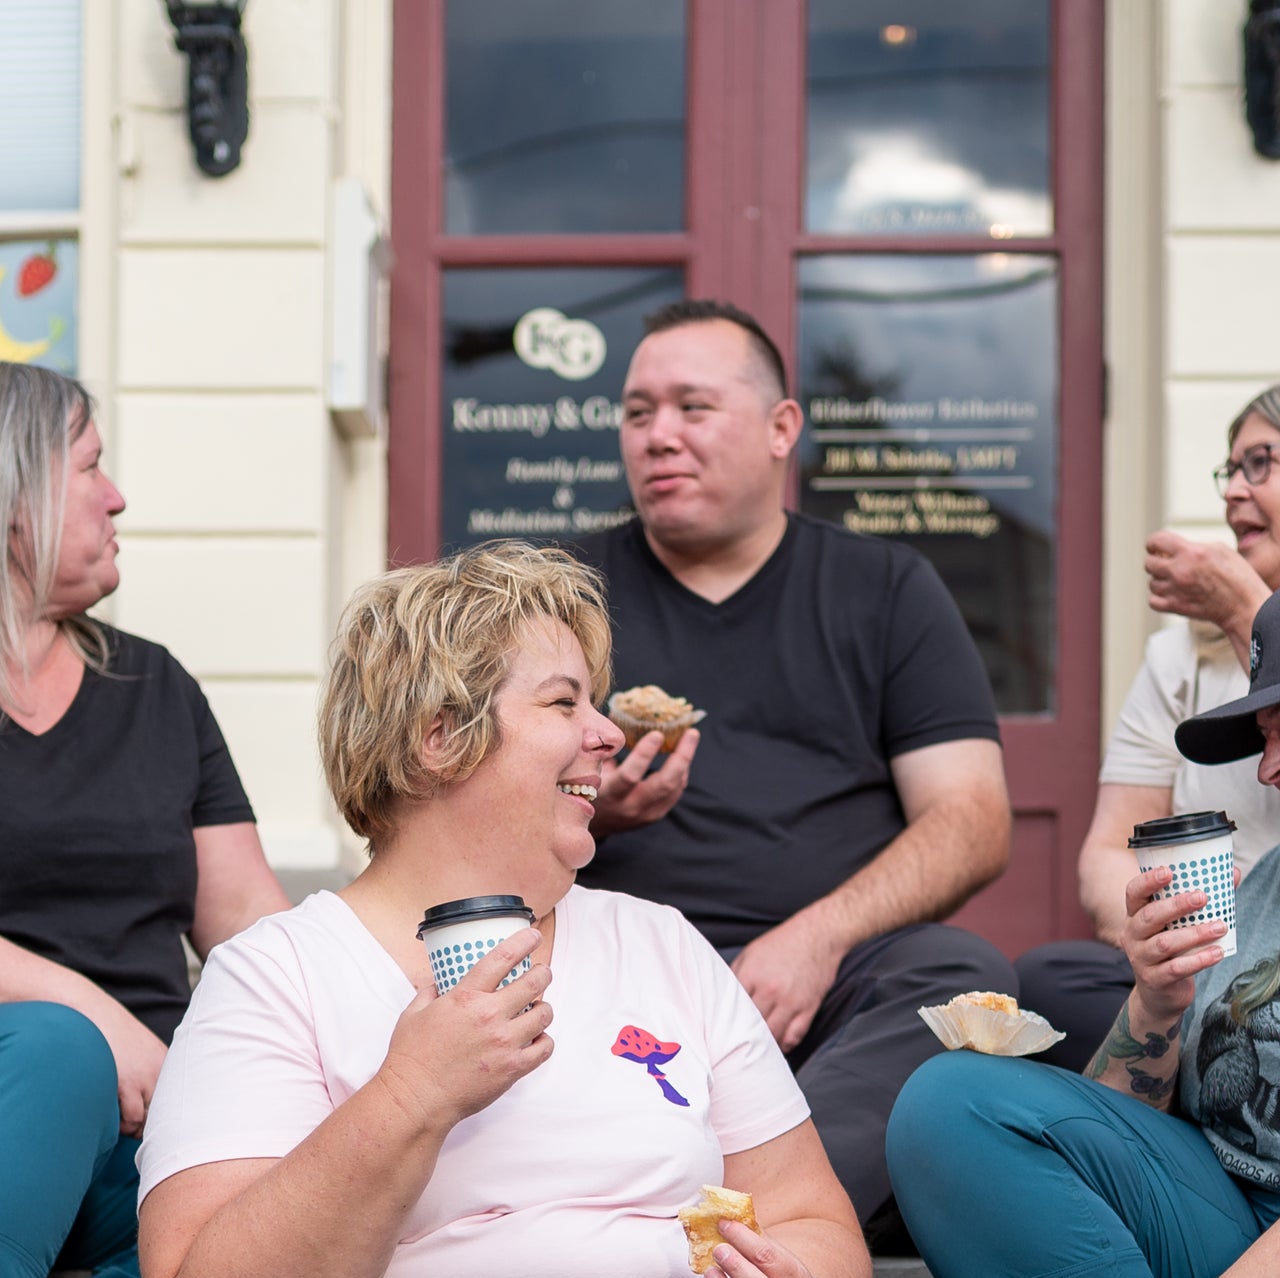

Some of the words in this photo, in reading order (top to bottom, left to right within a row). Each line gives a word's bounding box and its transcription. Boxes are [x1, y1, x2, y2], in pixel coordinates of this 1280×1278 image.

[452, 397, 553, 438] Kenny
[554, 396, 581, 431] &
[507, 457, 577, 484] Family
[1211, 1143, 1265, 1181] ANDARDS
